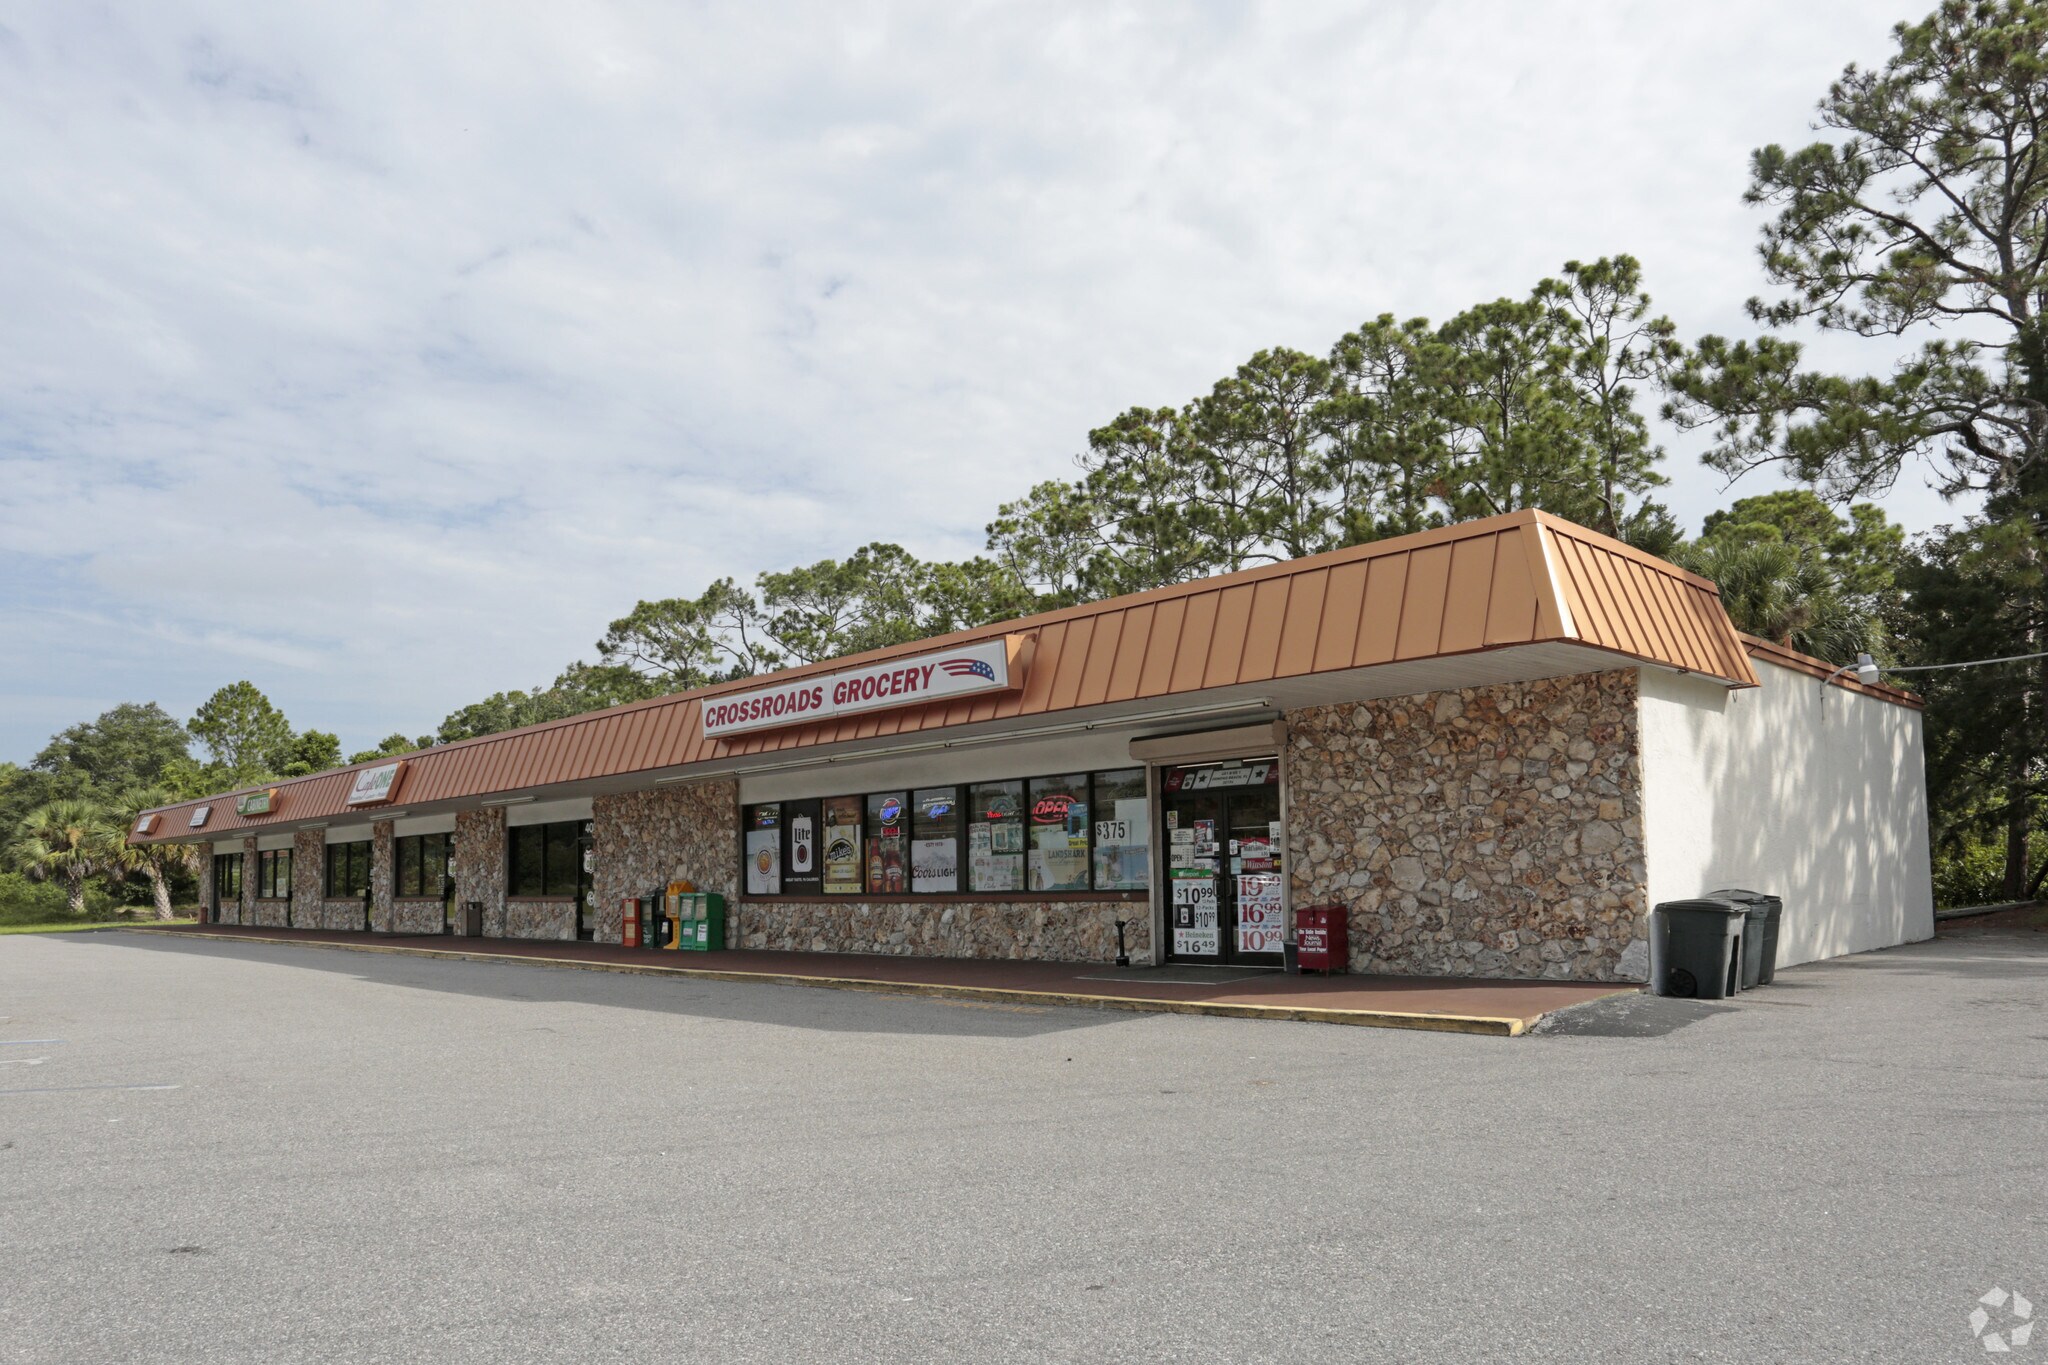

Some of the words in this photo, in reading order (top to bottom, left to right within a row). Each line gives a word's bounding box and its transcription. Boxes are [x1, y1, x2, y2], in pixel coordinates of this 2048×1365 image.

[705, 686, 824, 728] CROSSROADS
[833, 663, 937, 705] GROCERY
[793, 827, 811, 844] Lite
[1096, 821, 1126, 840] $375
[1048, 849, 1086, 859] LANDSHARK
[1171, 854, 1183, 862] OPEN
[1247, 860, 1273, 869] Winston
[911, 865, 937, 879] Coors
[1185, 931, 1214, 939] Heineken
